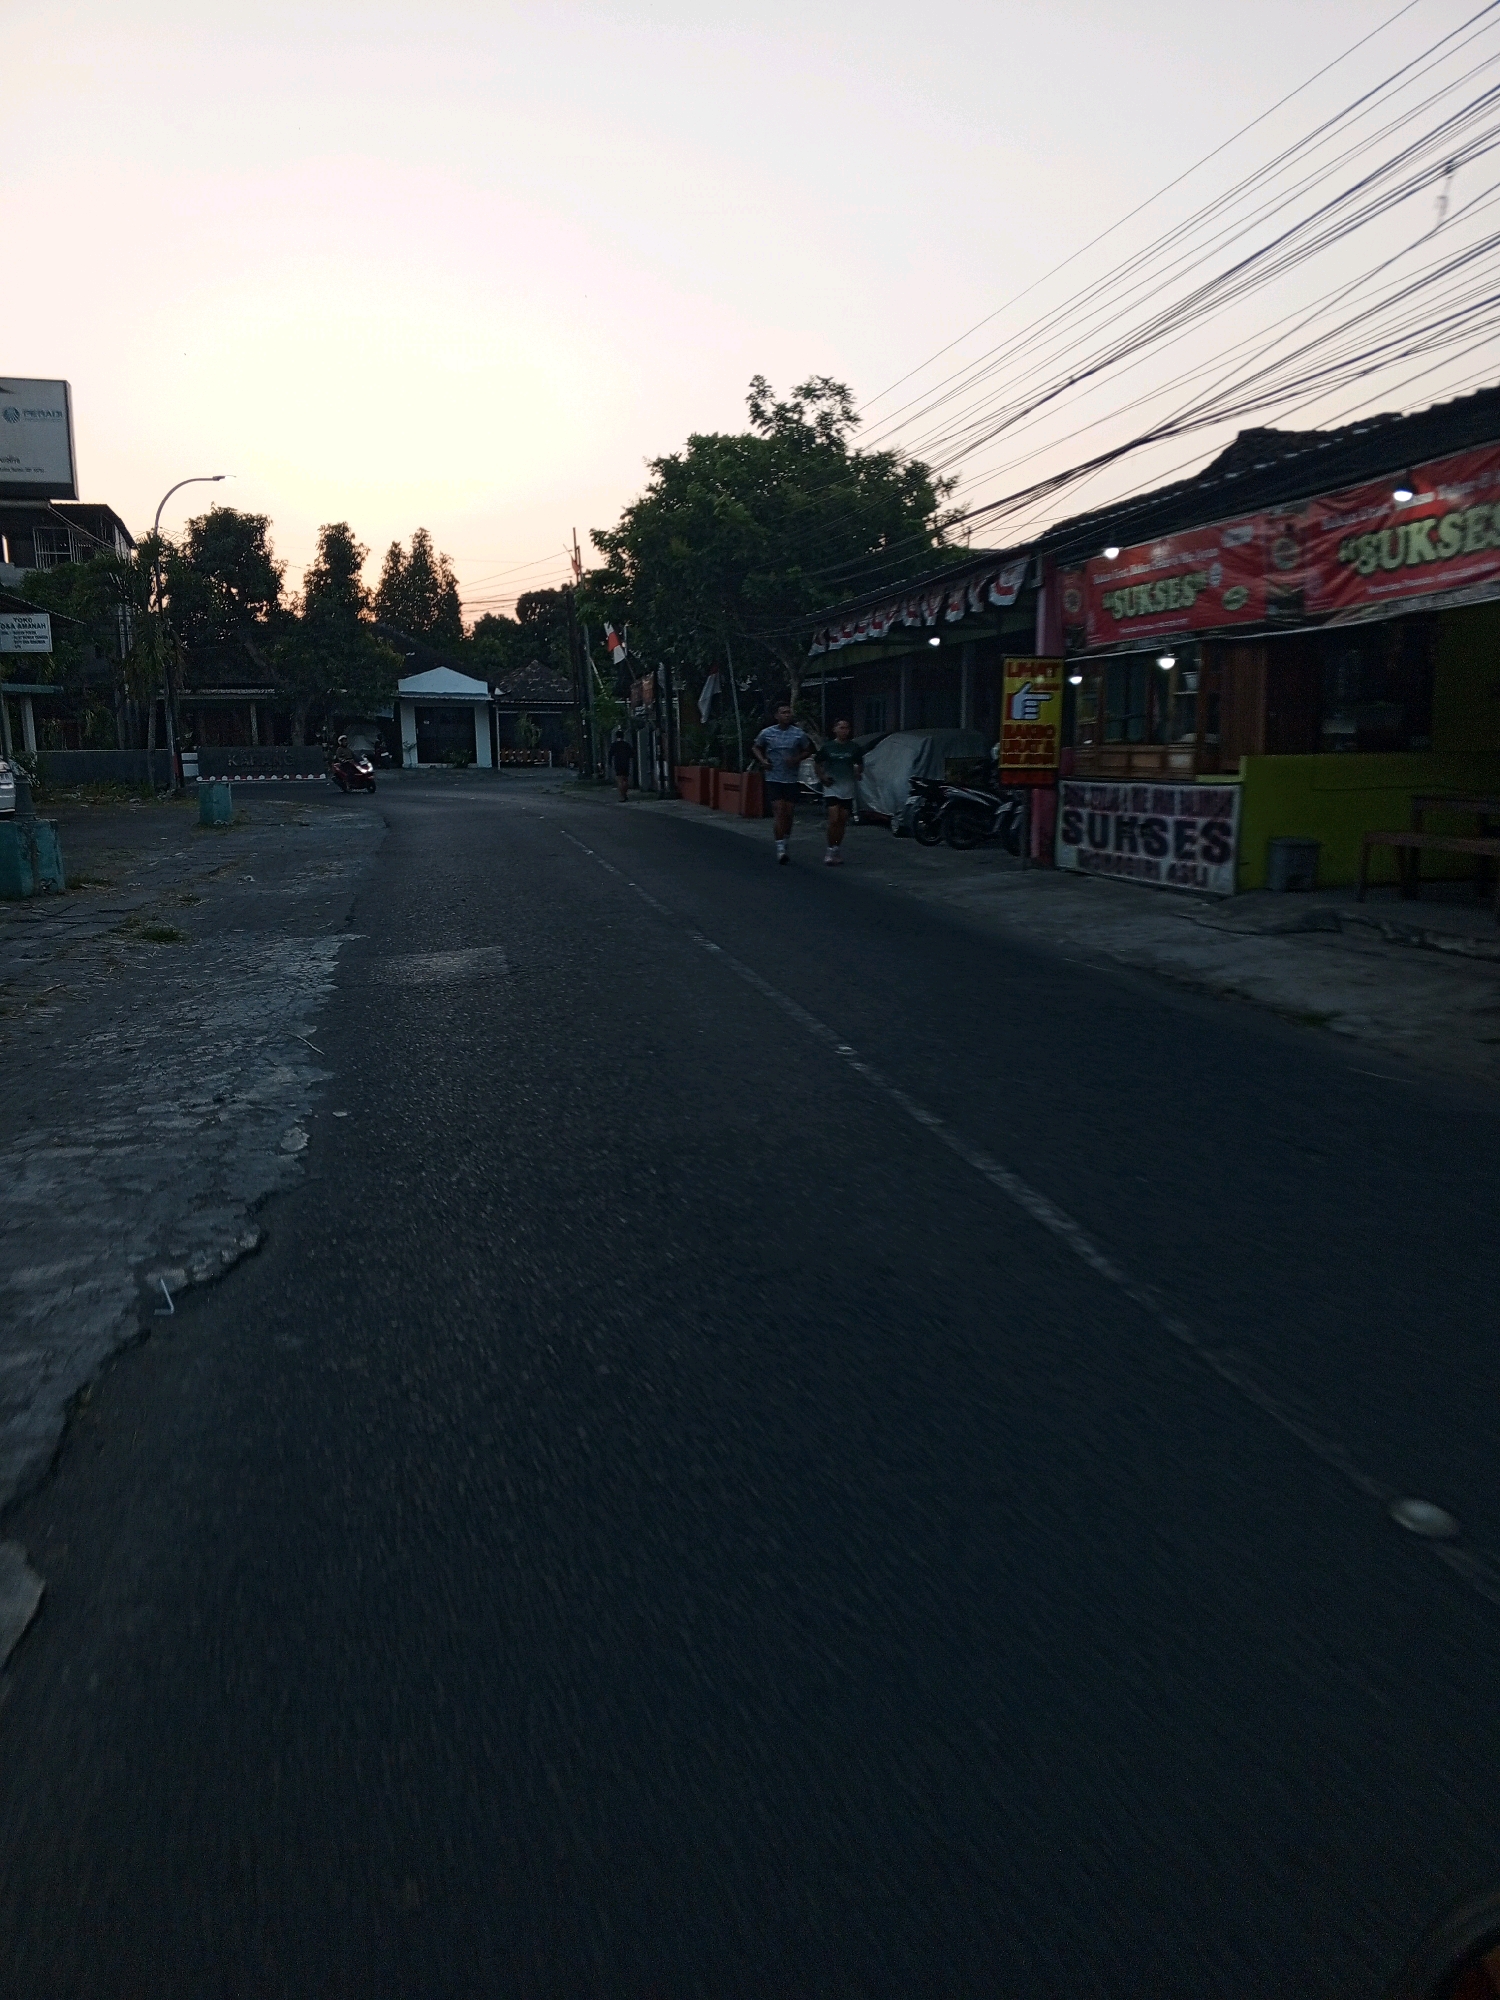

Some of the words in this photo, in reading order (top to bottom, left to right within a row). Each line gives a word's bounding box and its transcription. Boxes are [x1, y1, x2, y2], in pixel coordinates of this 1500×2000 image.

[1338, 500, 1500, 576] “SUKSE
[1007, 662, 1059, 677] LIHAT
[1004, 724, 1054, 739] BAKSO
[1003, 740, 1043, 753] URAT
[1062, 810, 1232, 864] SUKSES
